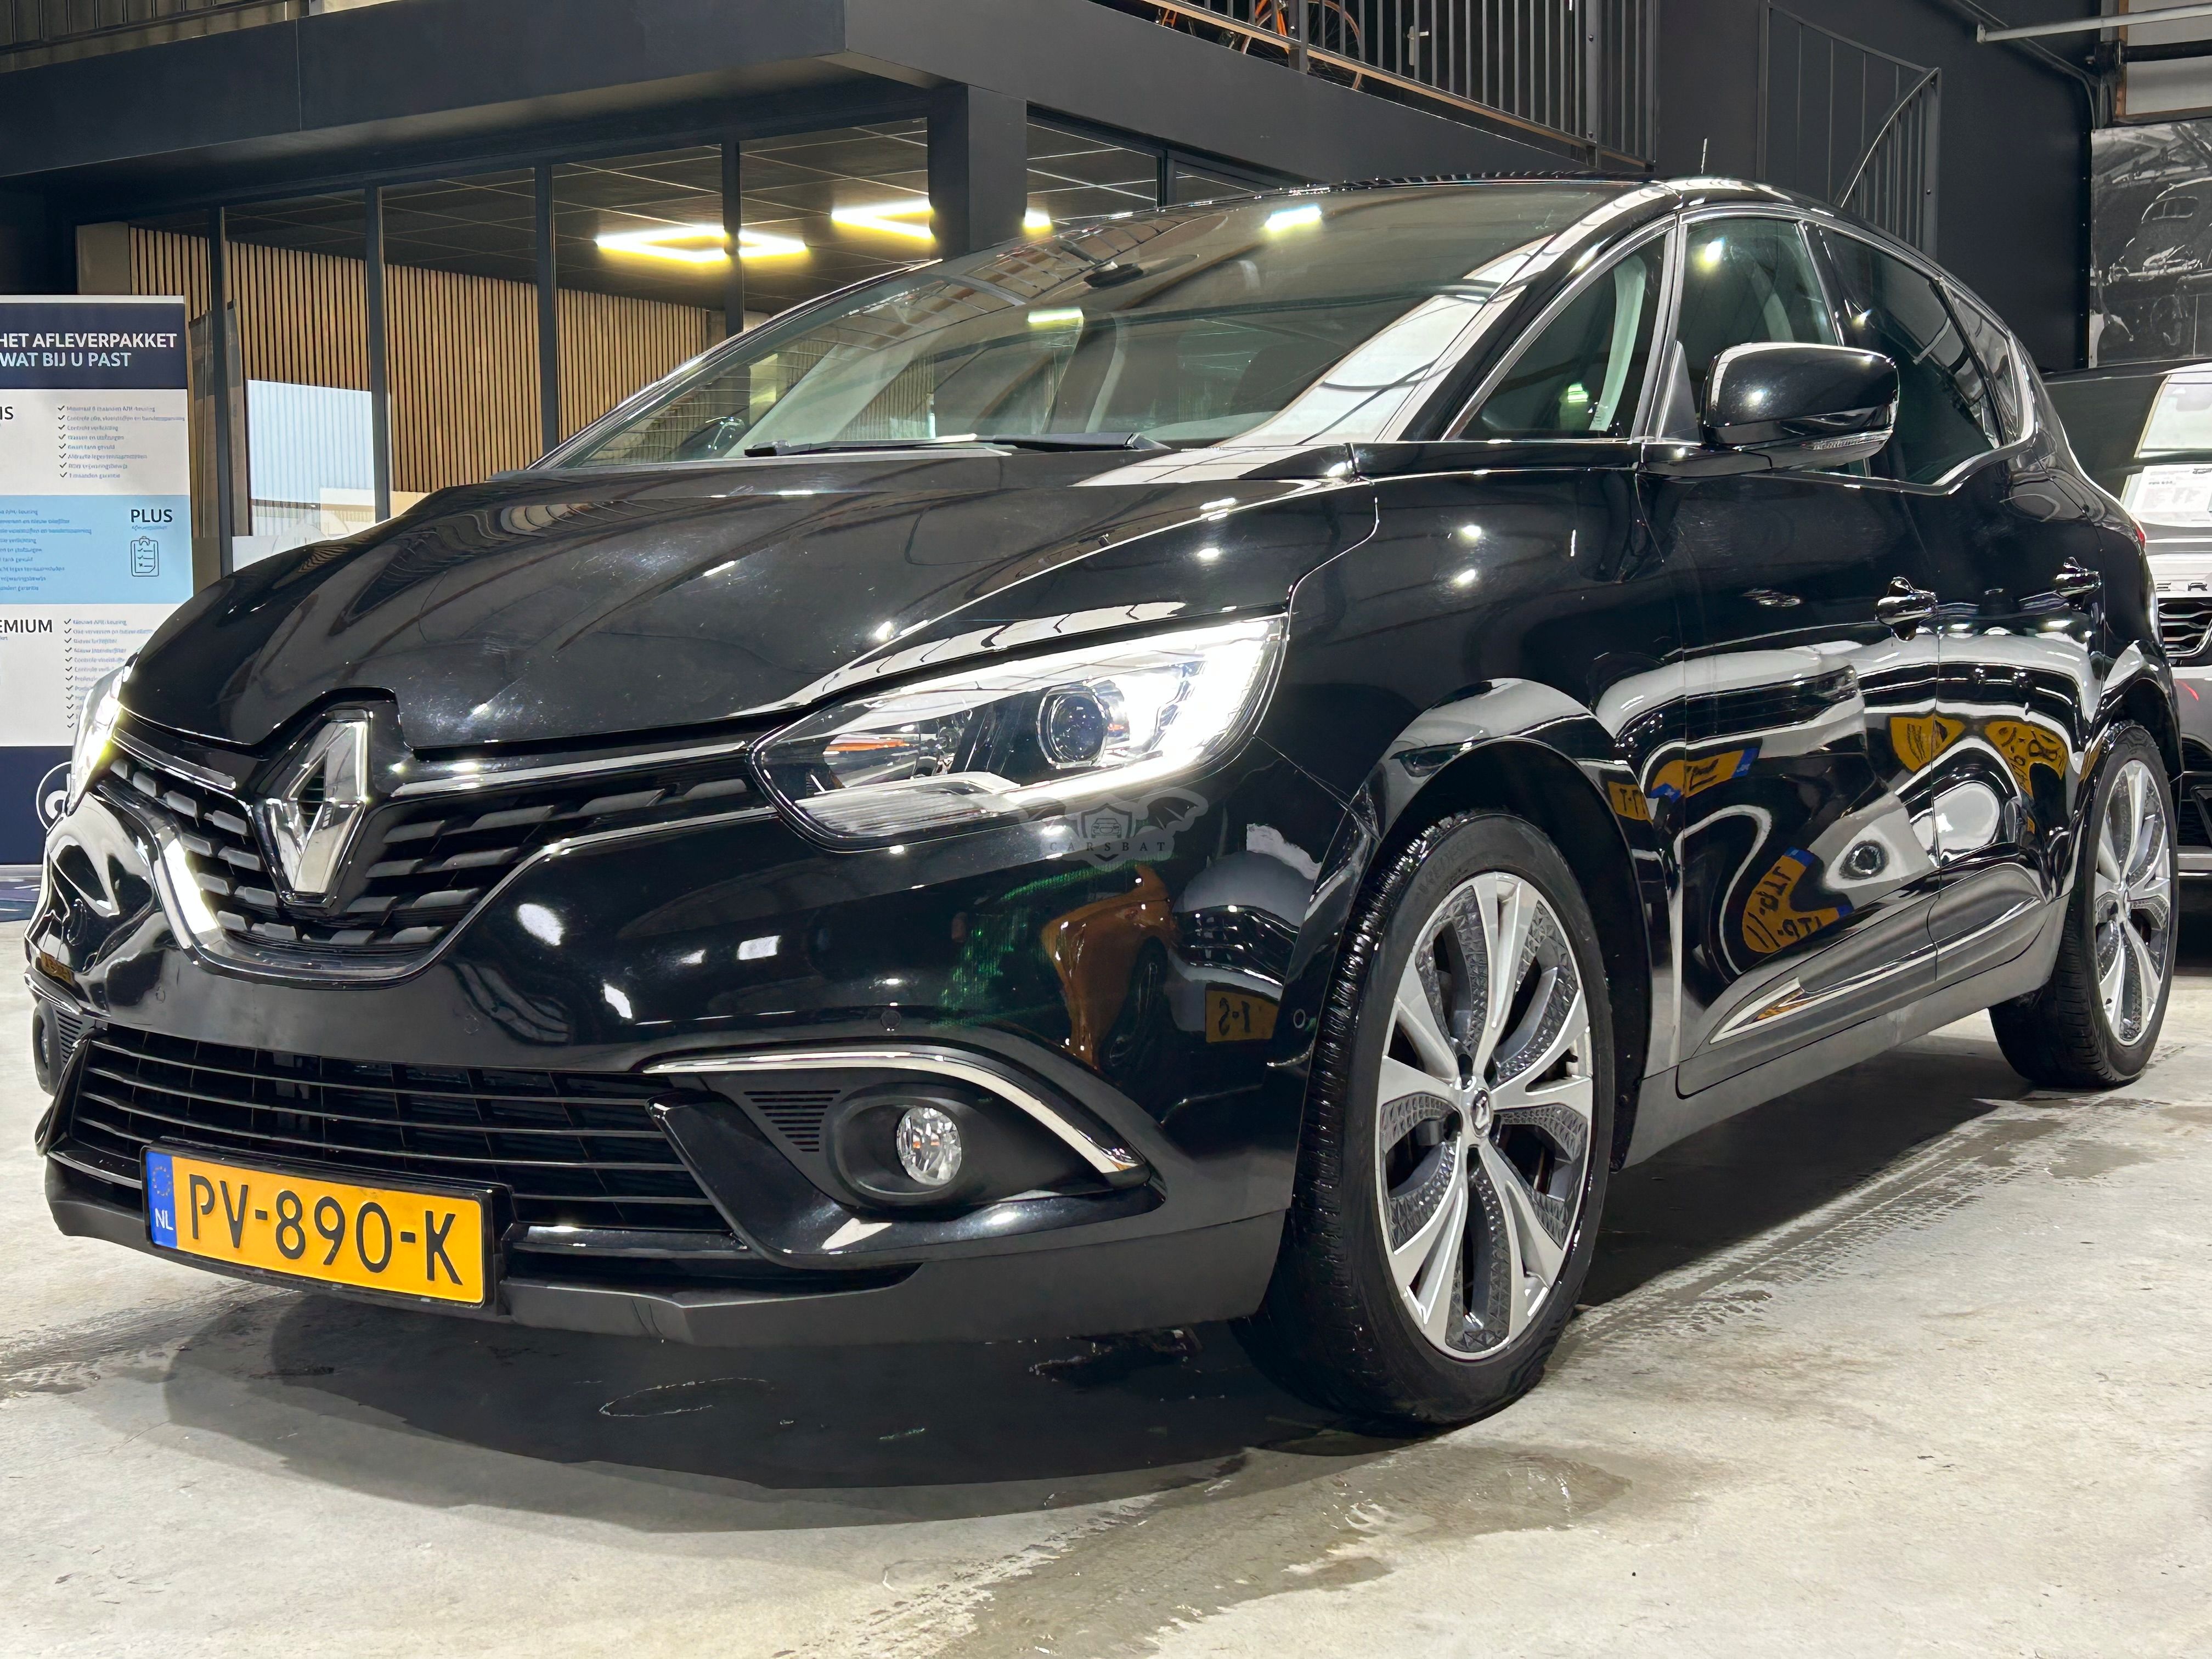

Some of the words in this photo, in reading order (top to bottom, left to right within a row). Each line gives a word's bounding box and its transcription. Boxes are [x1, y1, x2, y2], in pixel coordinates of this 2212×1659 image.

[0, 332, 30, 347] HET
[32, 332, 177, 348] AFLEVERPAKKET
[0, 352, 38, 366] WAT
[43, 352, 66, 366] BIJ
[71, 352, 83, 366] U
[88, 352, 132, 366] PAST
[131, 509, 173, 523] PLUS
[155, 1207, 174, 1231] NL
[189, 1173, 464, 1285] PV-890-K
